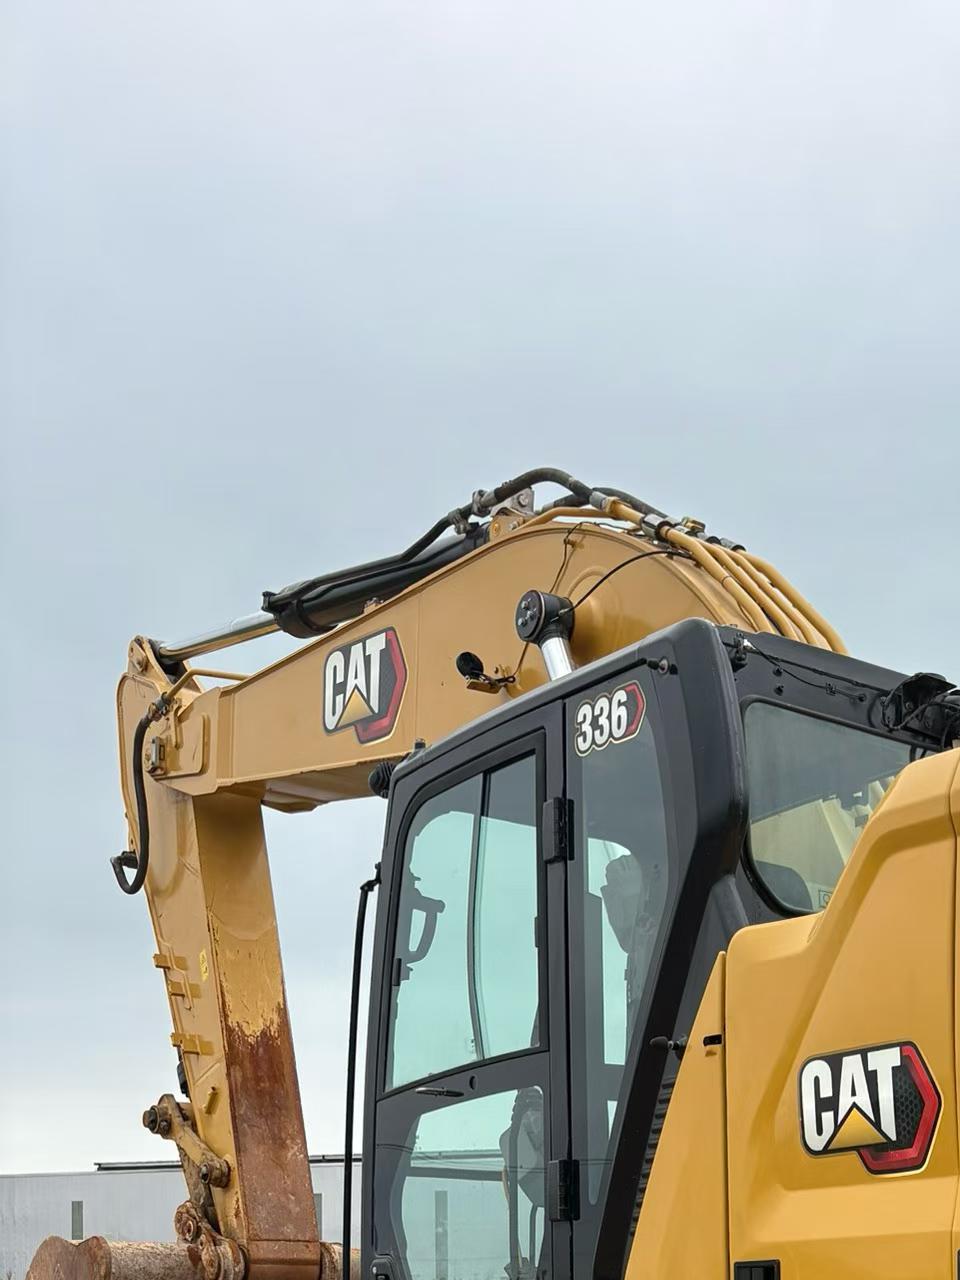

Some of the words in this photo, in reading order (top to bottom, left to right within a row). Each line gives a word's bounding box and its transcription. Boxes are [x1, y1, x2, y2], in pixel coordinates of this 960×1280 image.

[324, 632, 386, 730] CAT
[576, 688, 628, 751] 336
[801, 1047, 900, 1151] CAT
